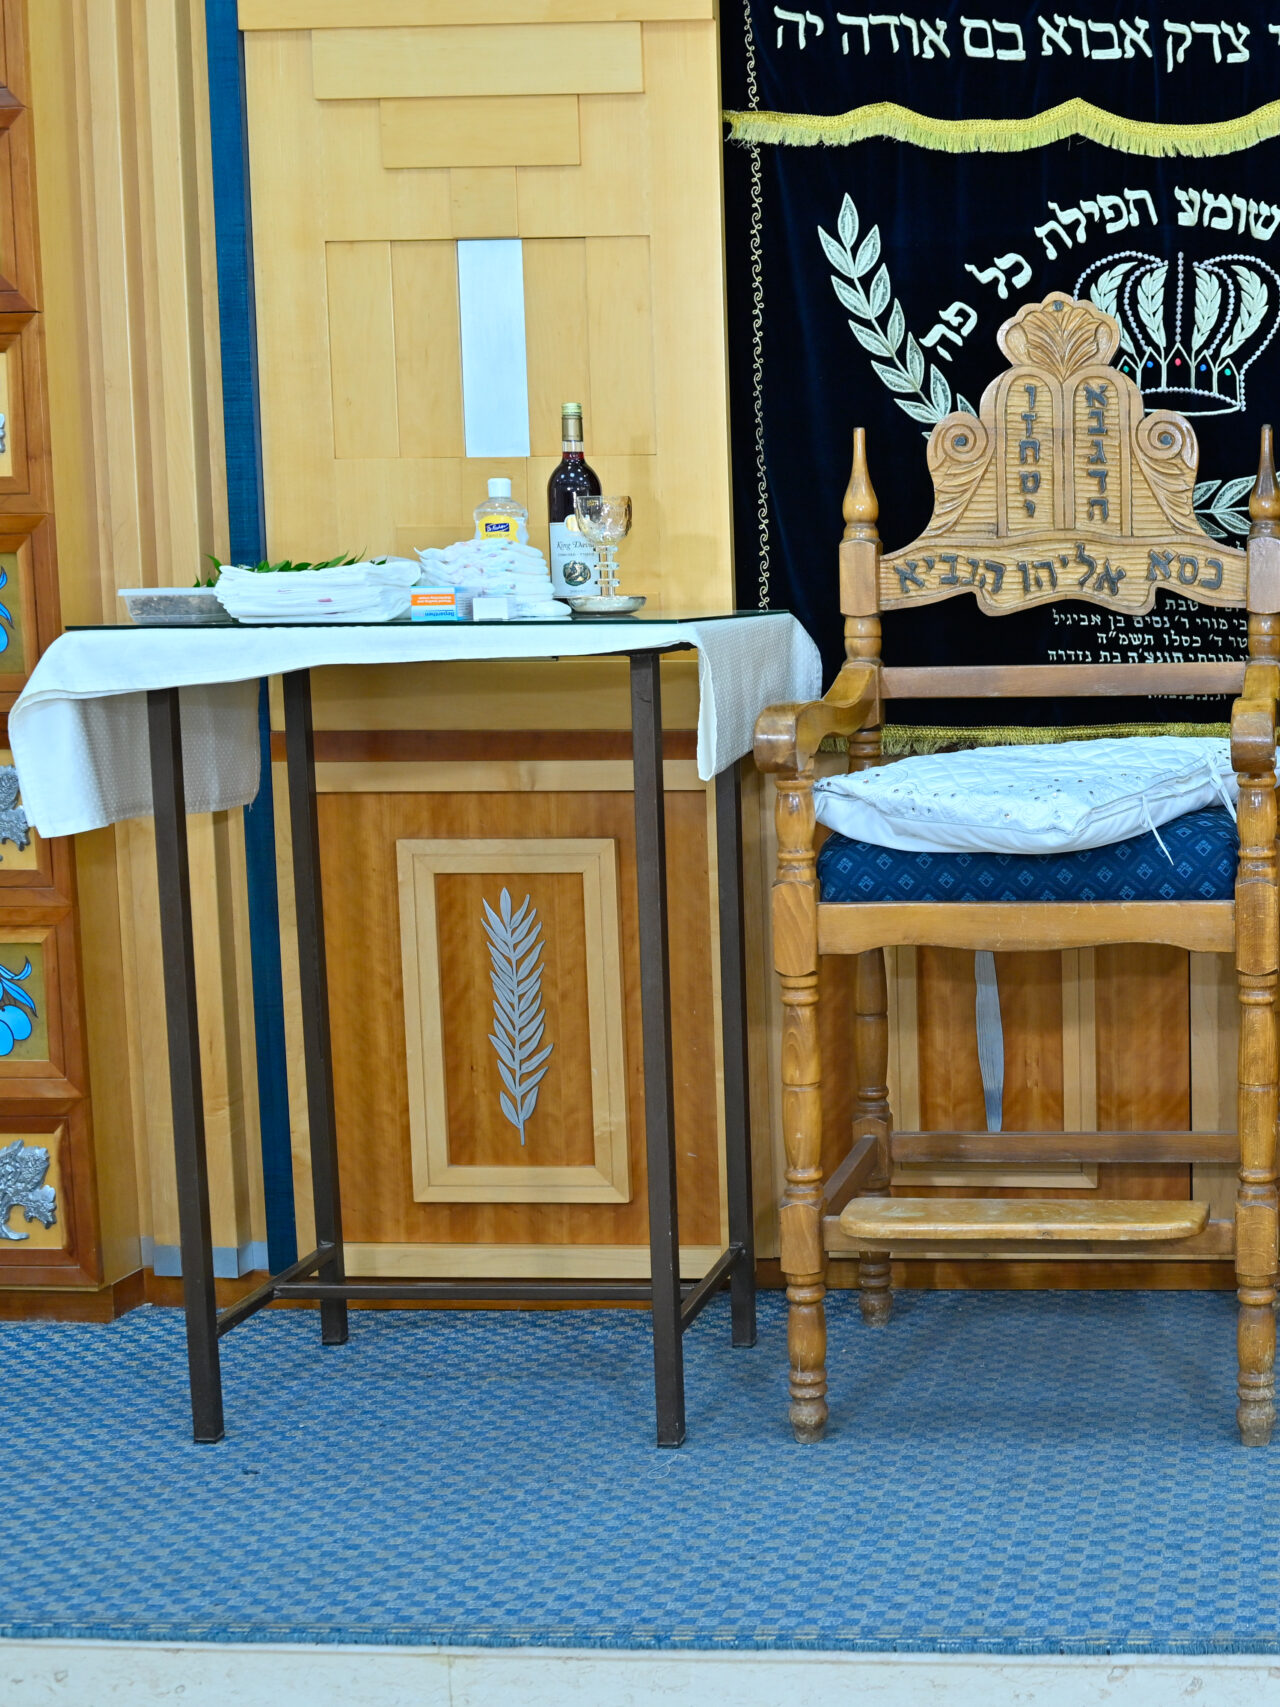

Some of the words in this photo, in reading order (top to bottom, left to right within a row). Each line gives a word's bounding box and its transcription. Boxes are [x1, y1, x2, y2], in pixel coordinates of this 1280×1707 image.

[774, 6, 824, 49] יה
[837, 13, 950, 59] אודה
[960, 16, 1026, 60] בם
[1038, 14, 1152, 59] אבוא
[1164, 19, 1250, 72] צדק
[1034, 187, 1158, 260] תפילת
[965, 253, 1032, 299] כל
[918, 302, 977, 363] פה
[557, 541, 571, 551] King
[894, 553, 1006, 593] הנביא
[1018, 542, 1126, 595] אליהו
[1147, 550, 1223, 590] כסא
[1053, 609, 1101, 626] אביגיל
[1109, 615, 1125, 630] בן
[1133, 615, 1170, 628] נסים
[1165, 599, 1199, 611] טבת
[1196, 618, 1228, 629] מורי
[1099, 650, 1121, 663] בת
[1163, 630, 1201, 647] כסלו
